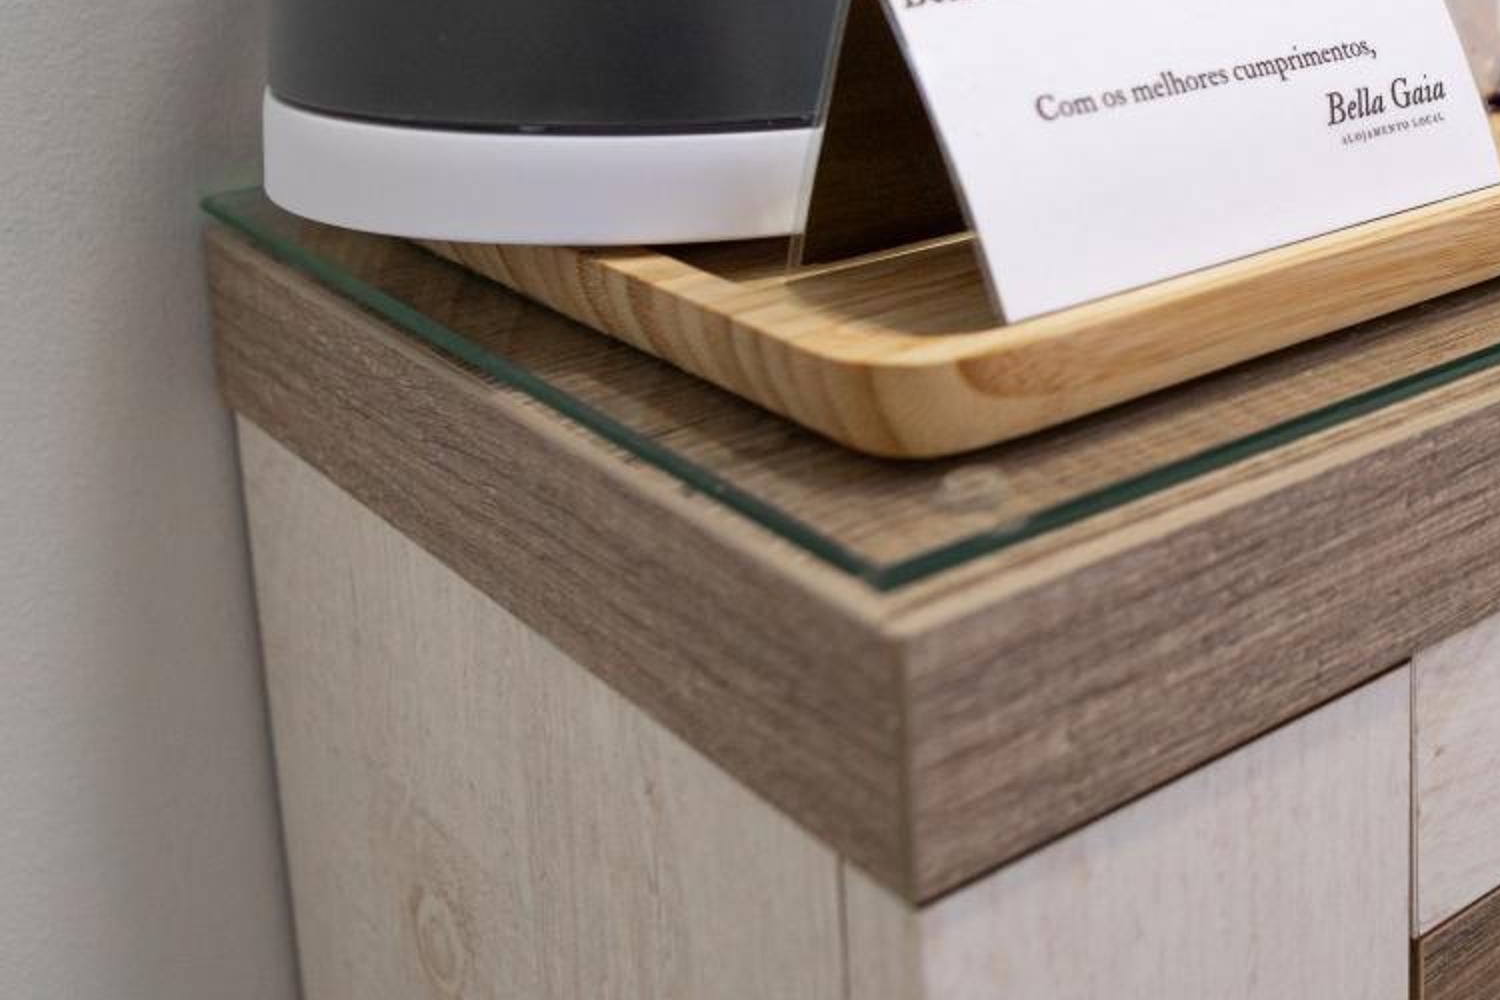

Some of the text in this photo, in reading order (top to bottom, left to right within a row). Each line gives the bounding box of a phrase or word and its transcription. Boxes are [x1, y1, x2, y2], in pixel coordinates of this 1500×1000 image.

[1034, 39, 1378, 121] Com os melhores cumprimentos,
[1325, 73, 1447, 127] Bella Gaia
[1411, 111, 1446, 128] LOCAL
